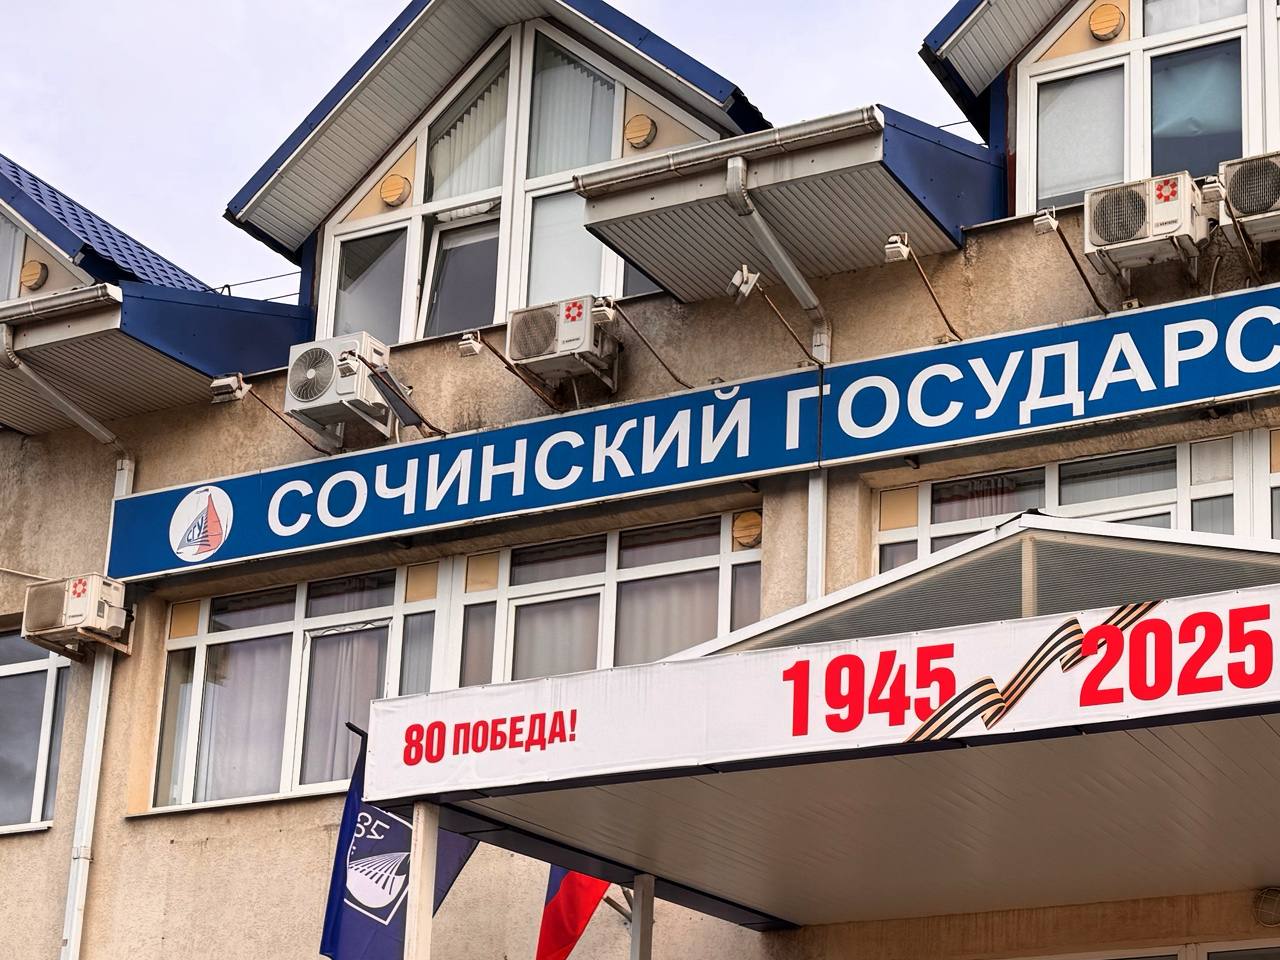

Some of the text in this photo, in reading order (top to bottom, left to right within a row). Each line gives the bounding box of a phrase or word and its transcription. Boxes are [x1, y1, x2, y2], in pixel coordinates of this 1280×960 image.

[267, 386, 750, 536] СОЧИНСКИЙ
[782, 604, 1274, 737] 1945 2025
[403, 709, 577, 766] 80 ПОБЕДА!
